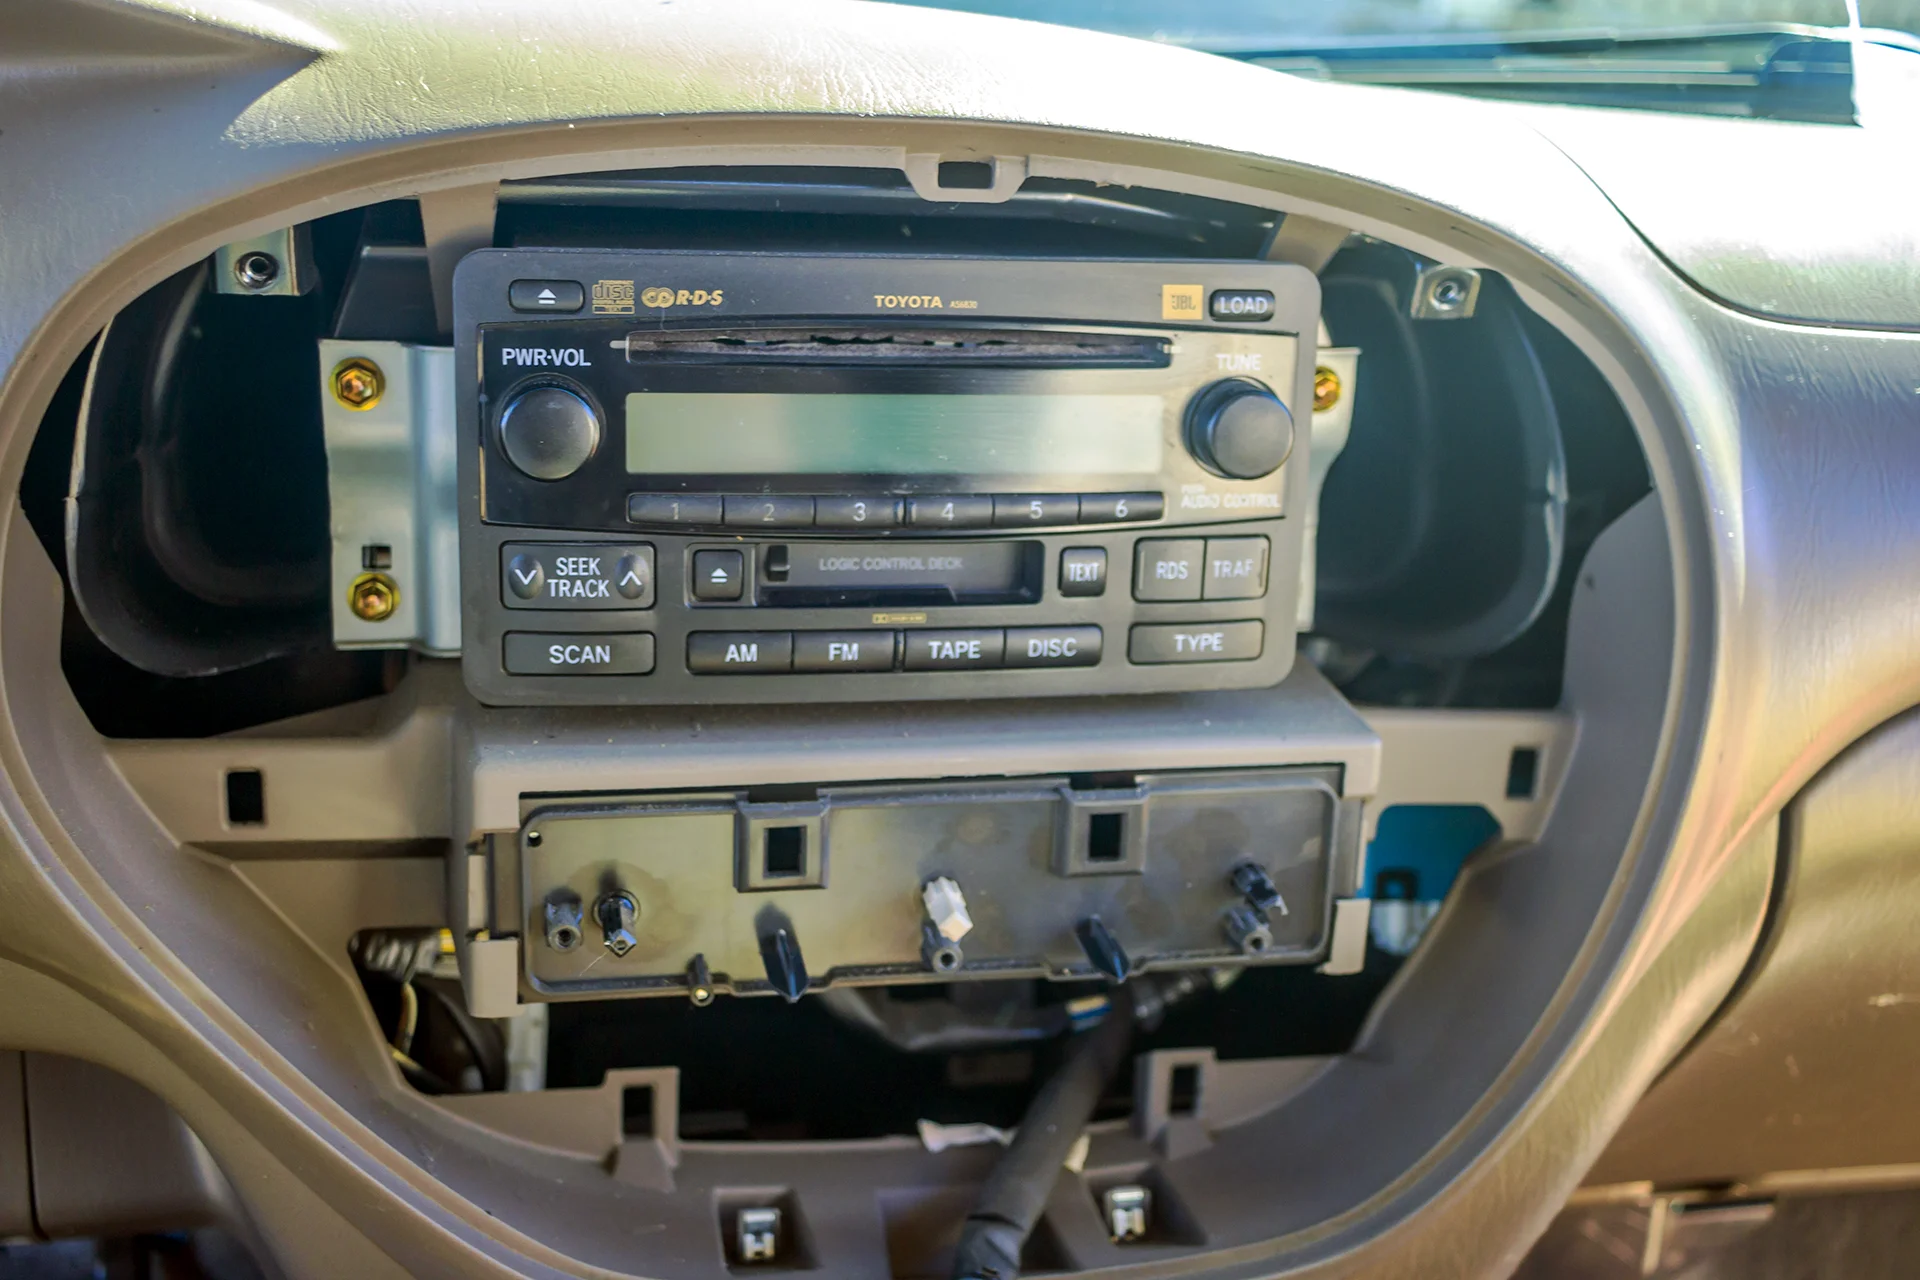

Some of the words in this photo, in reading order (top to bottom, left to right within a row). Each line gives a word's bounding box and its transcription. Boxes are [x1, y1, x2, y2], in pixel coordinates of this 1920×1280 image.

[874, 295, 943, 308] TOYOTA
[1171, 295, 1196, 310] JBL
[1219, 296, 1268, 314] LOAD
[1215, 353, 1262, 371] TUNE
[1029, 501, 1043, 519] 5
[1115, 499, 1128, 518] 6
[1180, 493, 1220, 508] AUDIO
[670, 502, 680, 520] 1
[762, 503, 775, 522] 2
[853, 502, 867, 522] 3
[940, 502, 954, 521] 4
[555, 557, 601, 576] SEEK
[819, 557, 860, 571] LOGIC
[862, 557, 925, 571] CONTROL
[927, 557, 964, 570] DECK
[1068, 562, 1099, 582] TEXT
[1155, 560, 1189, 580] RDS
[1213, 559, 1254, 578] TRAF
[547, 579, 610, 597] TRACK
[828, 642, 859, 661] FM
[928, 640, 981, 660] TAPE
[1027, 637, 1077, 658] DISC
[1174, 632, 1224, 653] TYPE
[549, 645, 611, 664] SCAN
[725, 643, 758, 662] AM
